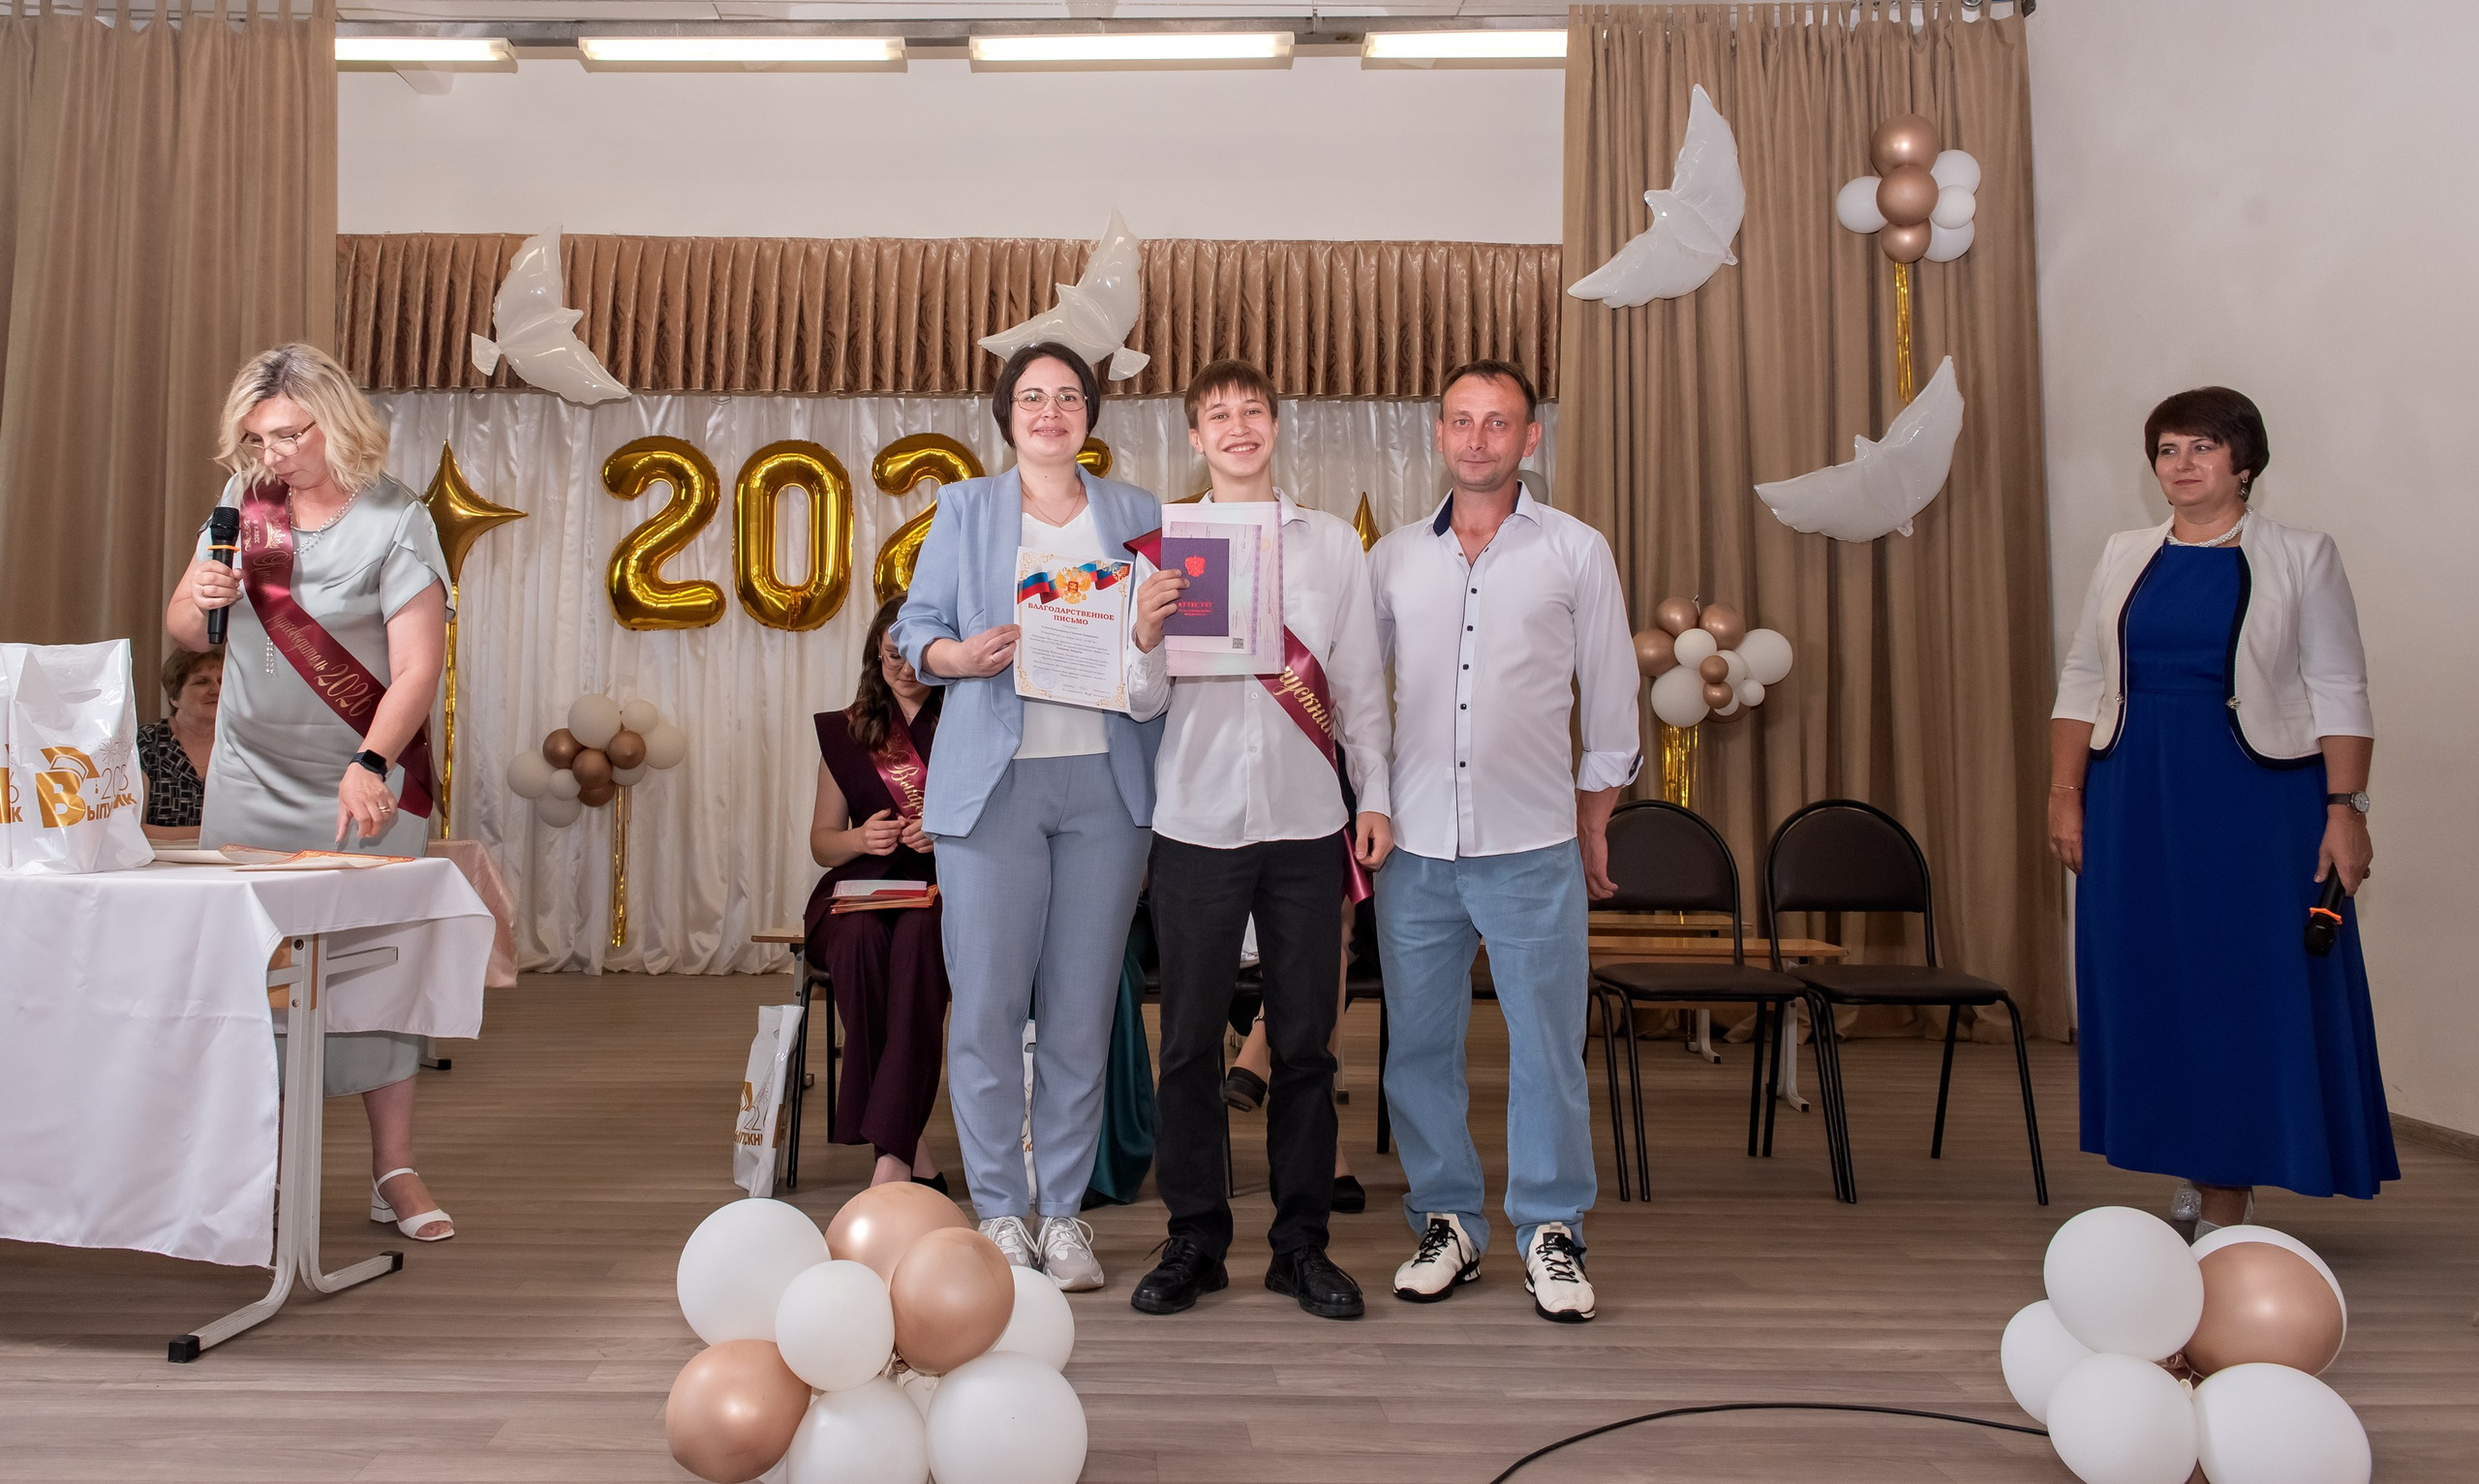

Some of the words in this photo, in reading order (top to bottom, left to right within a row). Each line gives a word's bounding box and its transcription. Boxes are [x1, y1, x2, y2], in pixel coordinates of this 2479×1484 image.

[600, 433, 1113, 632] 202
[1027, 602, 1115, 621] БЛАГОДАРСТВЕННОЕ
[1054, 615, 1088, 625] ПИСЬМО
[314, 663, 374, 717] 2026
